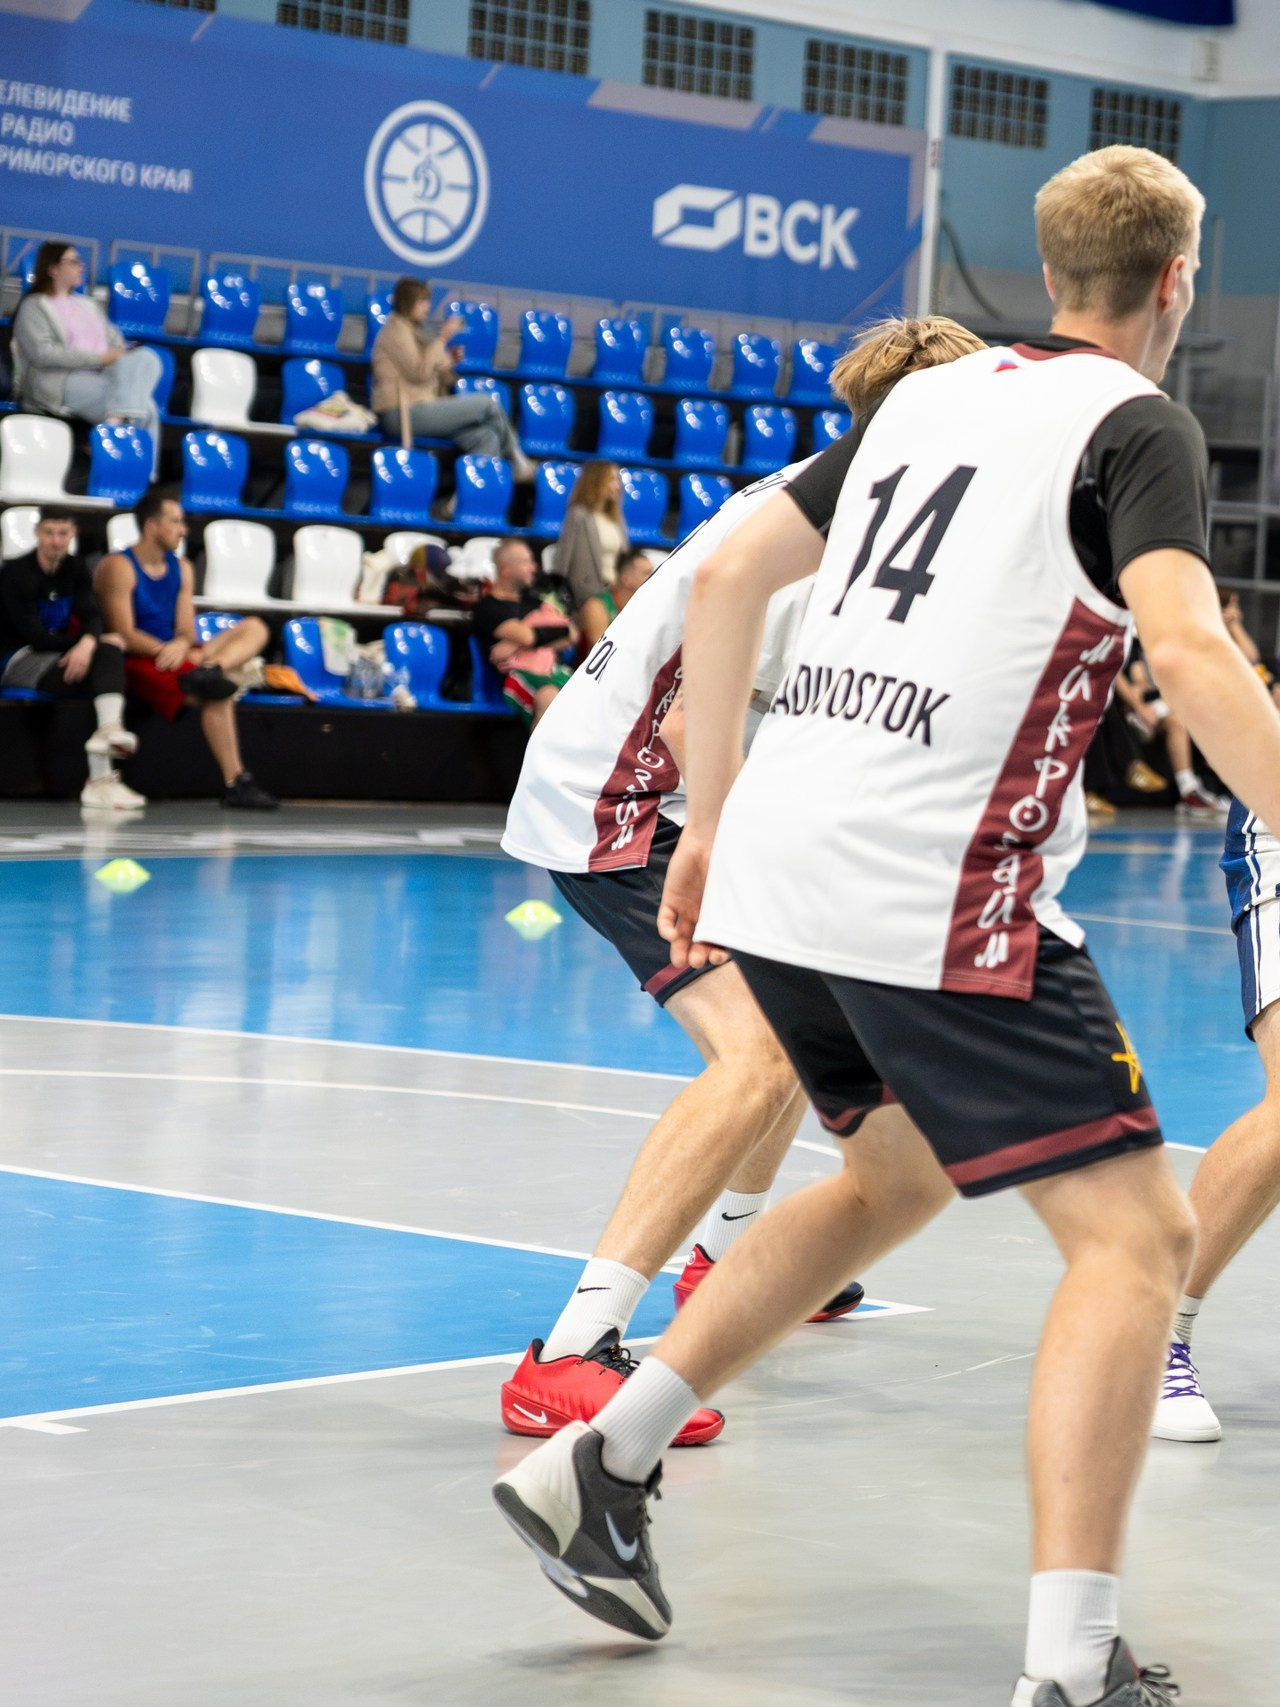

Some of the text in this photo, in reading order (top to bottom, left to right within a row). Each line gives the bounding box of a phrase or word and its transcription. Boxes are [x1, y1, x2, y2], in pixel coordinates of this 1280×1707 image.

[1, 111, 75, 148] РАДИО
[139, 163, 194, 195] КРАЯ
[743, 193, 861, 271] ВСК
[831, 463, 978, 625] 14
